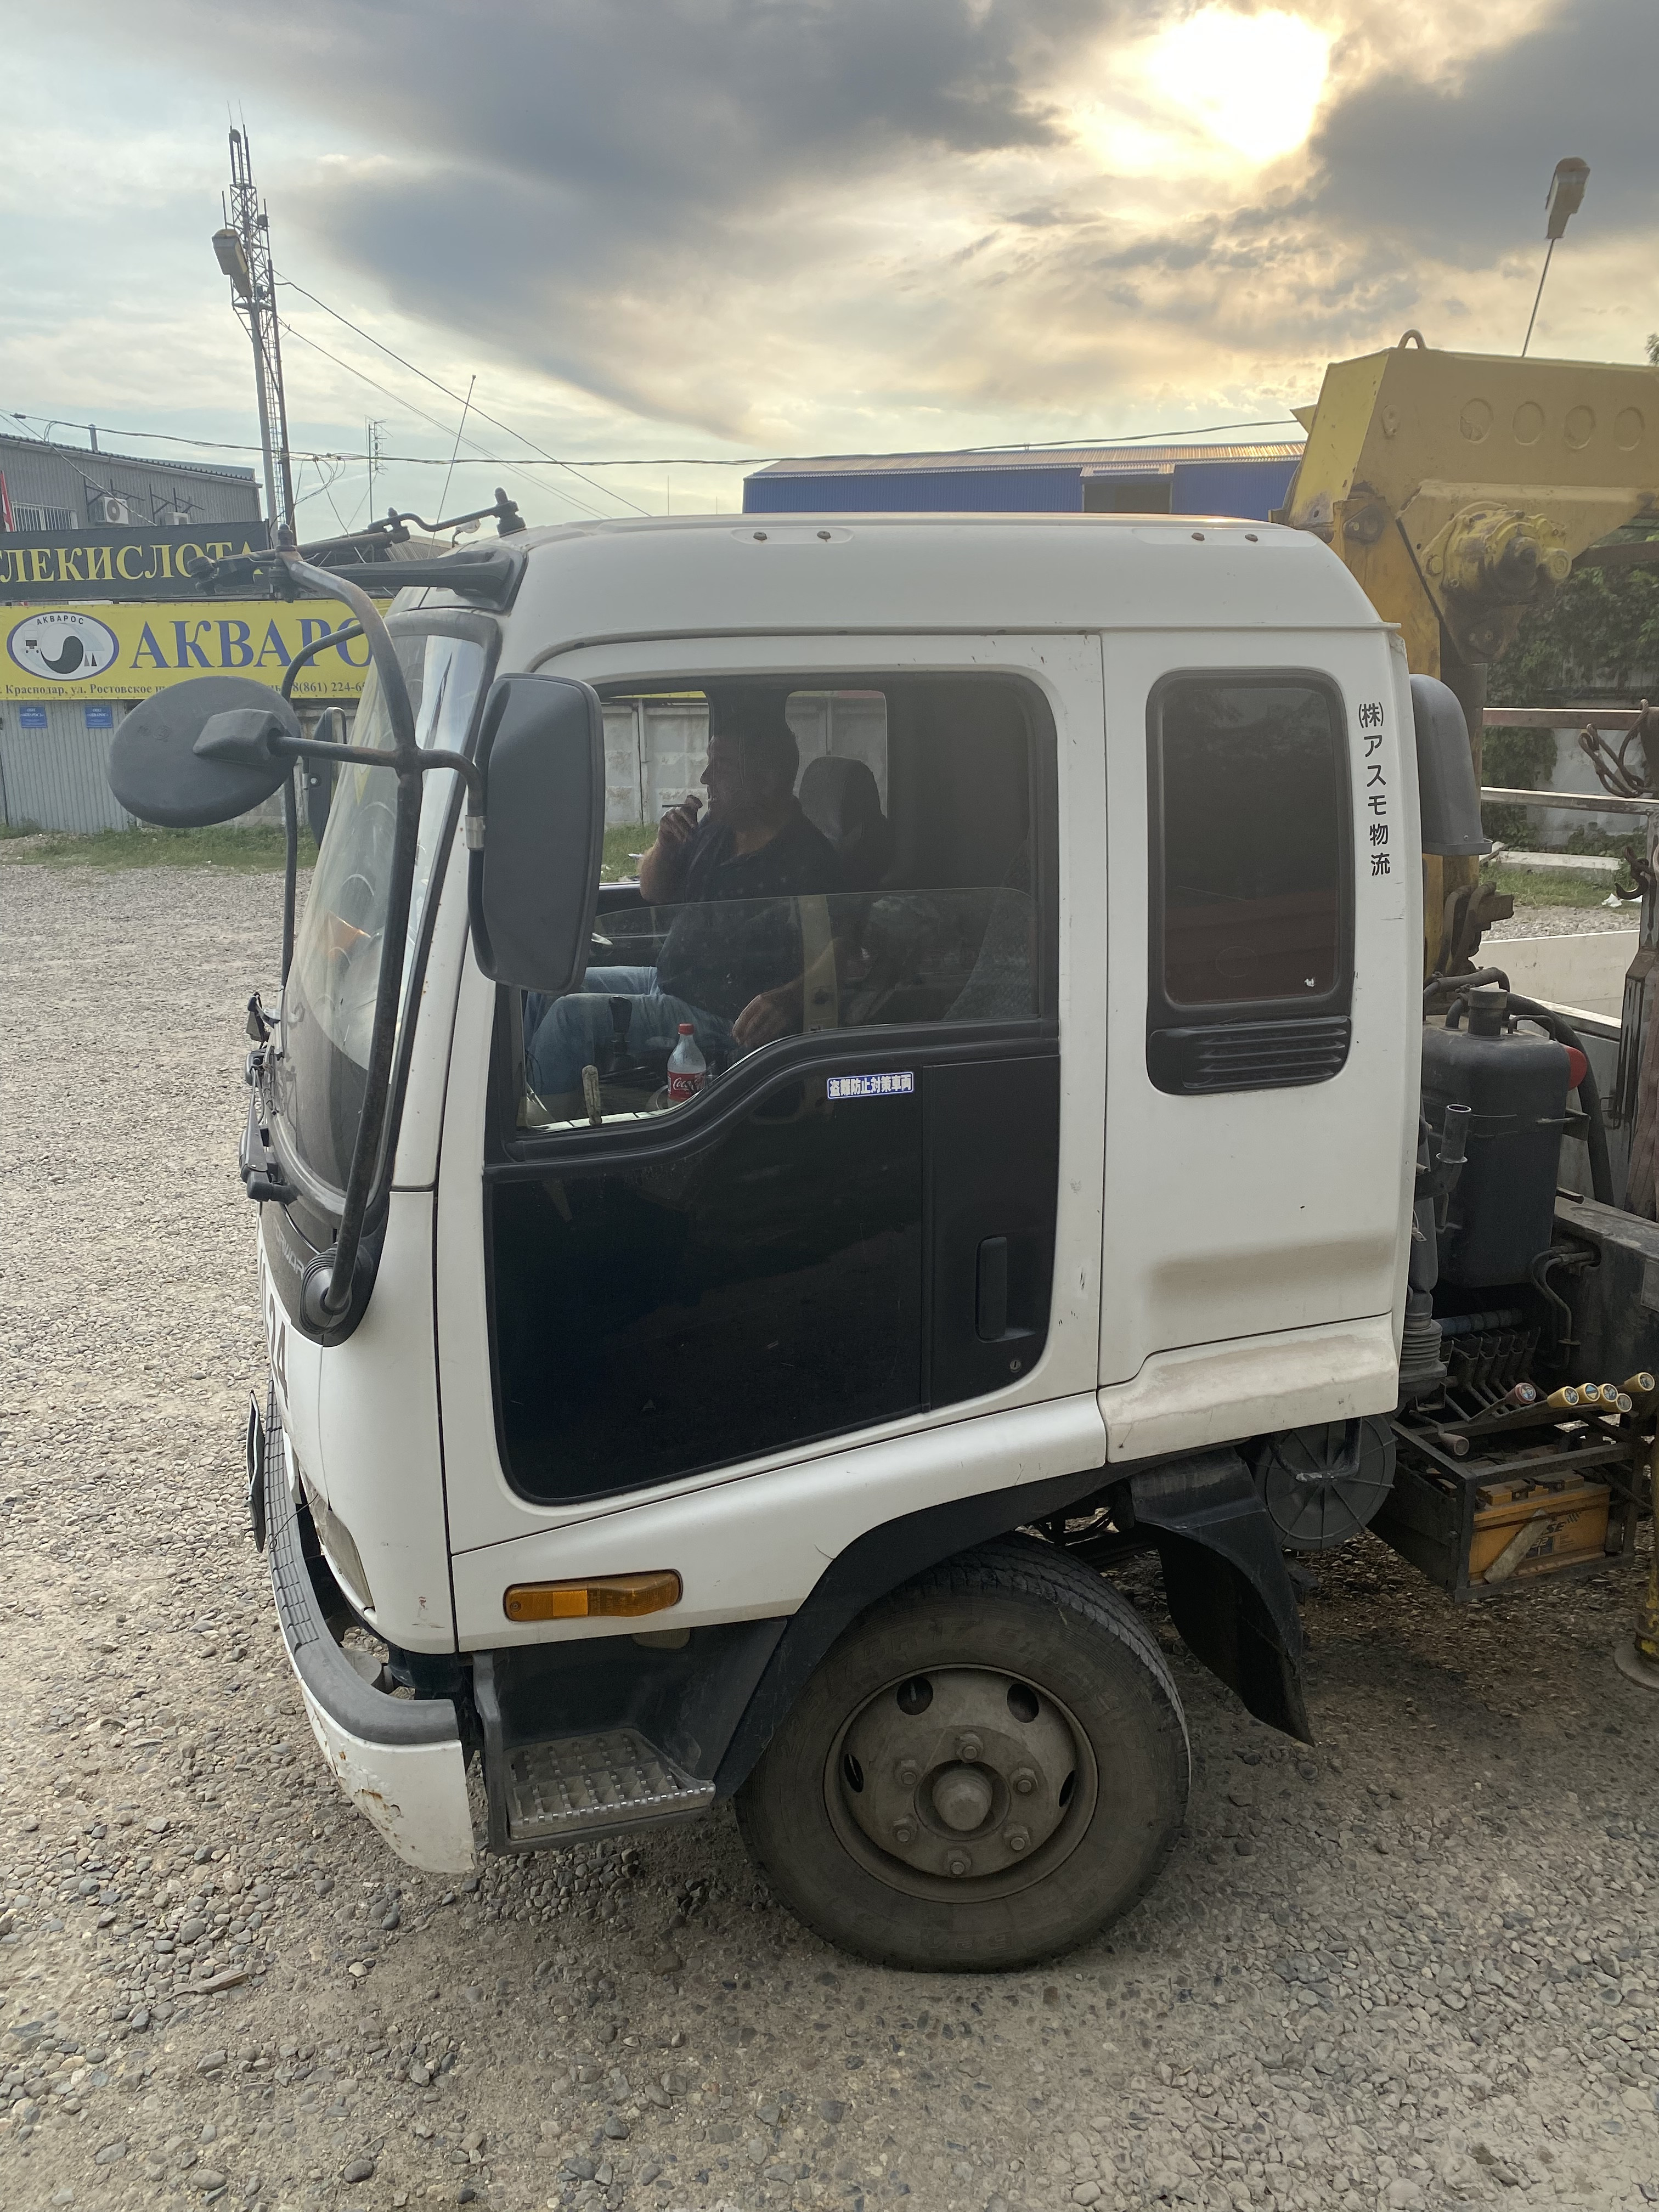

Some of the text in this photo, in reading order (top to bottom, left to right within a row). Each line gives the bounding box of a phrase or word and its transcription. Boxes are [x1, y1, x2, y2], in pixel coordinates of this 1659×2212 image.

[0, 541, 264, 583] ЛЕКИСЛОТ
[37, 615, 84, 625] АКВАРОС
[5, 684, 68, 696] Краснодар,
[71, 686, 87, 696] ул.
[91, 684, 152, 693] Ростовское
[292, 681, 328, 693] 8(861)
